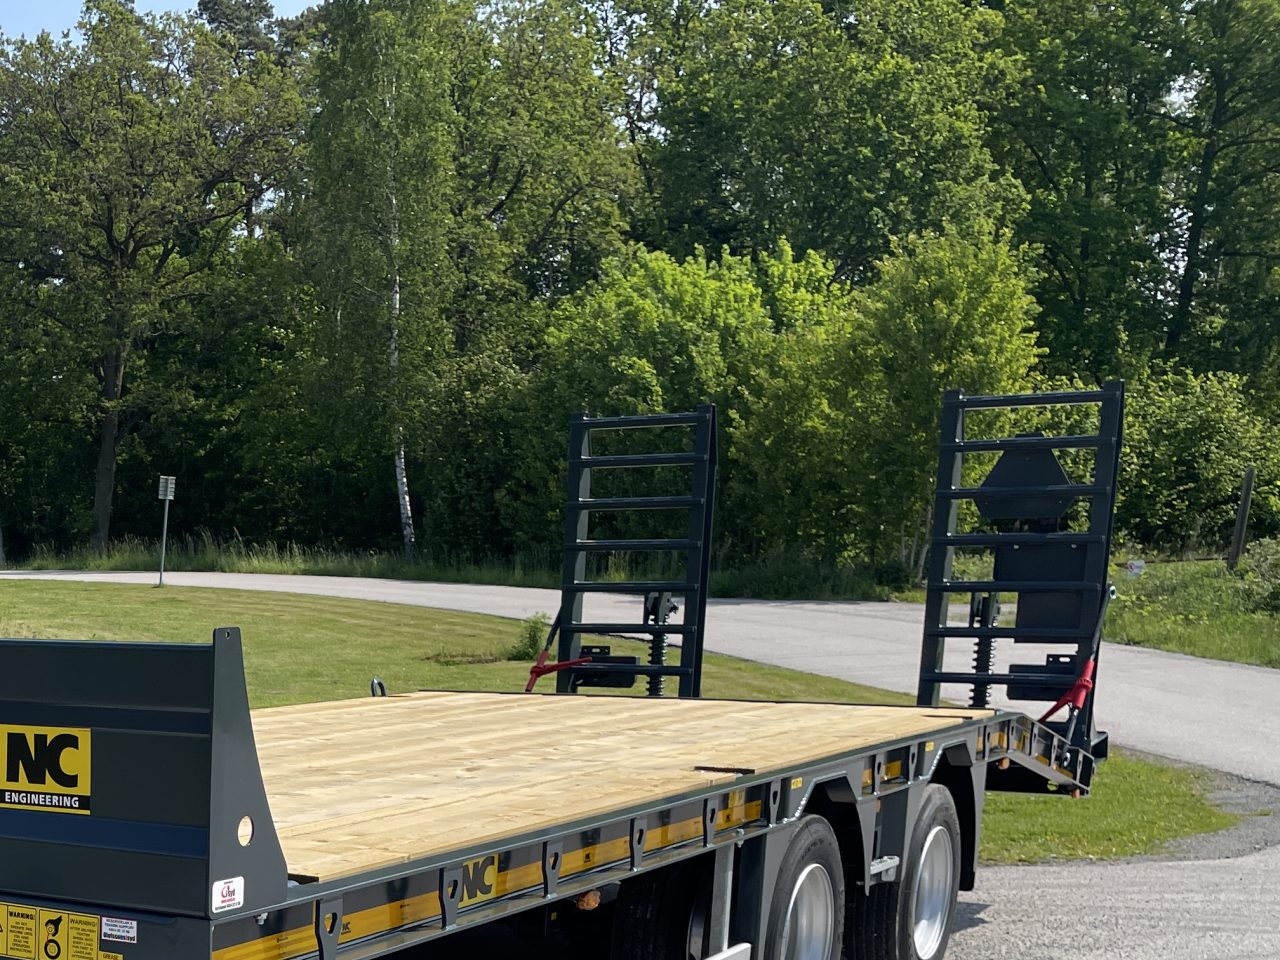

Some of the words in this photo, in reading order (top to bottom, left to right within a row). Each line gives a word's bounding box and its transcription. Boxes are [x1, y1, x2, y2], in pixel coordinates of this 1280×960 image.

[6, 732, 79, 788] NC
[5, 791, 79, 808] ENGINEERING
[460, 856, 495, 902] NC
